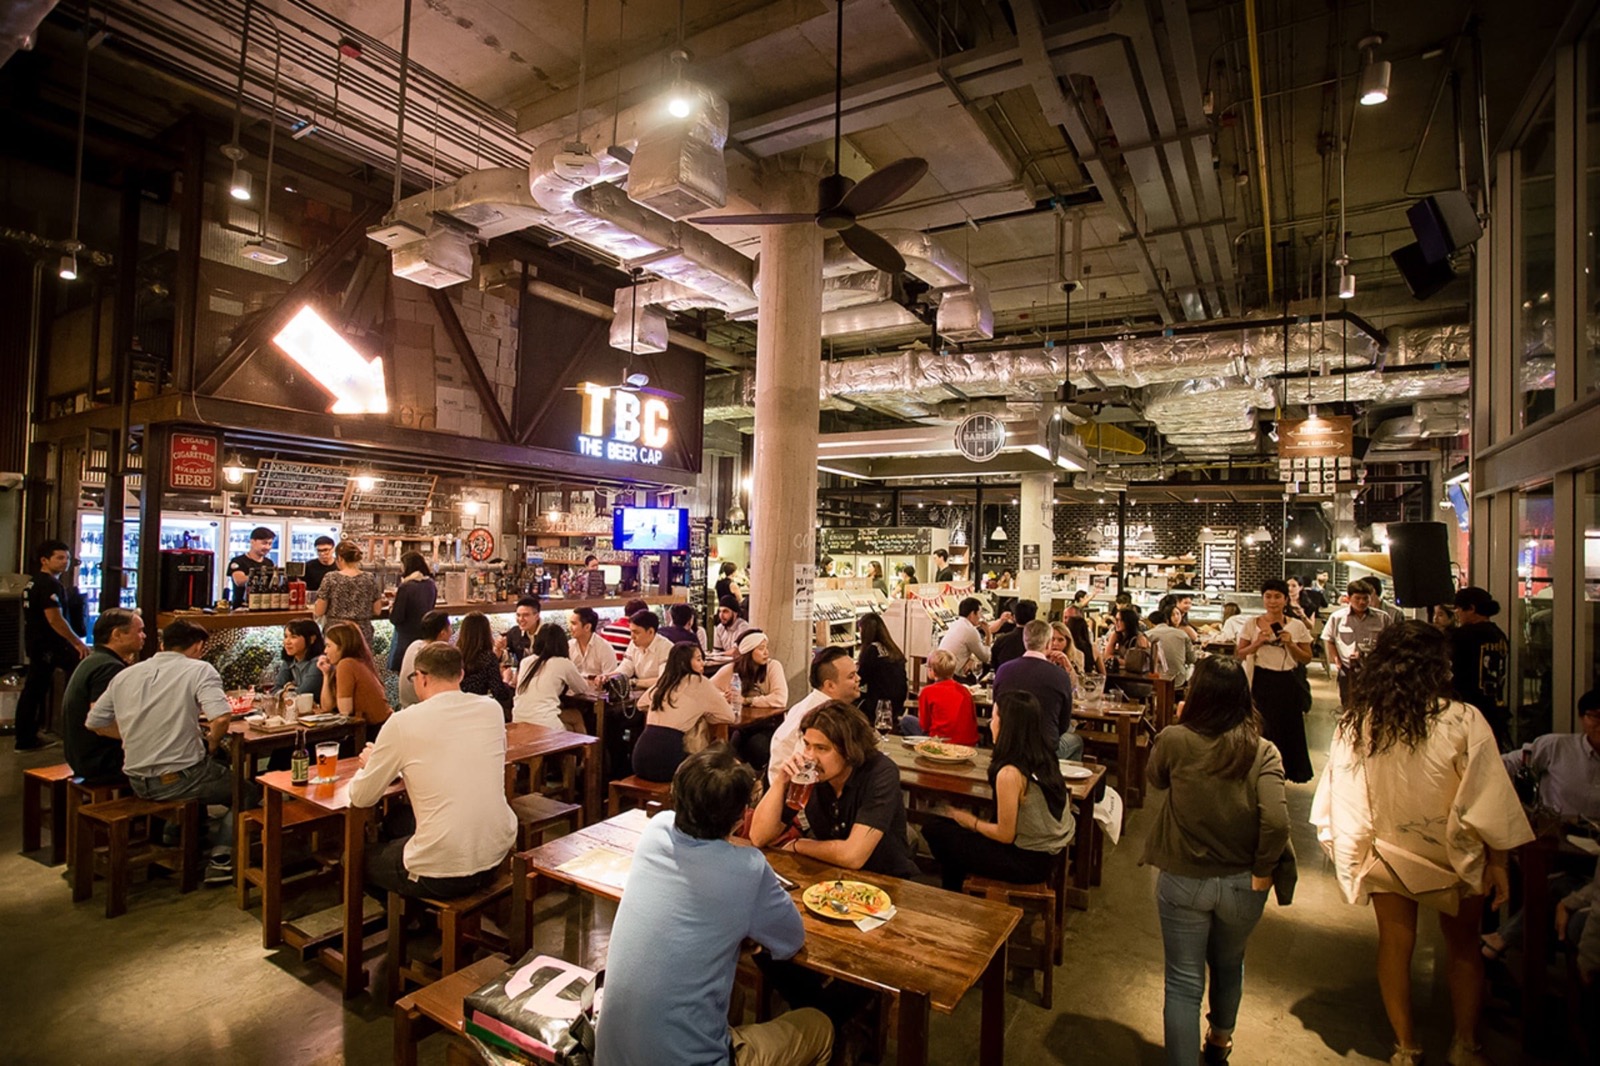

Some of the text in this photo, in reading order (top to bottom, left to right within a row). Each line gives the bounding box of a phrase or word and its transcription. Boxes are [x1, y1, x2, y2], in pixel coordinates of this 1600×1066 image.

[577, 382, 669, 449] TBC
[181, 437, 209, 446] CIGARS
[963, 431, 998, 441] BARREL
[578, 436, 662, 465] THE BEER CAP
[173, 451, 215, 463] CIGARETTES
[175, 465, 212, 474] AVAILABLE
[174, 473, 212, 487] HERE
